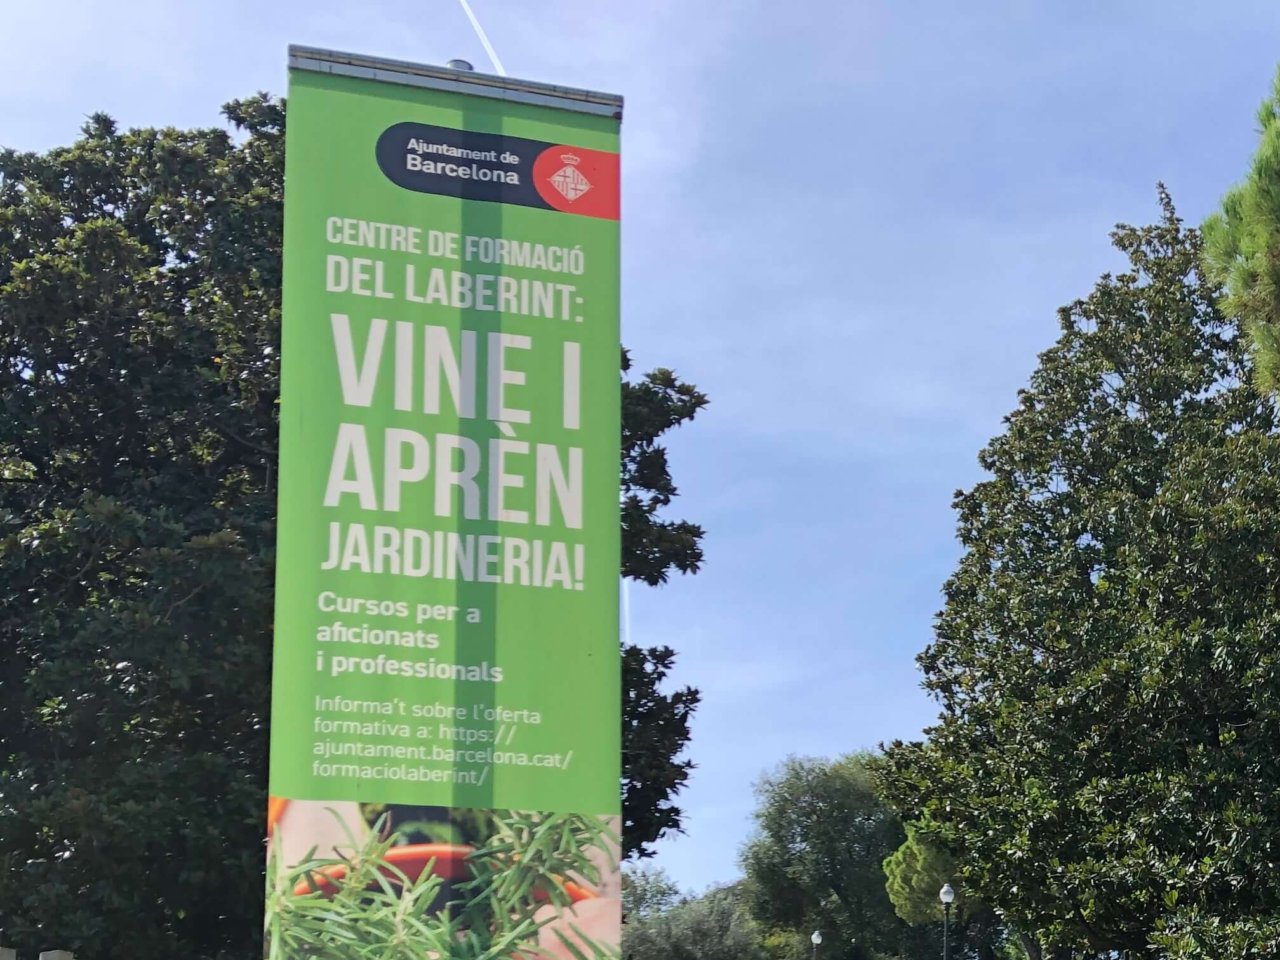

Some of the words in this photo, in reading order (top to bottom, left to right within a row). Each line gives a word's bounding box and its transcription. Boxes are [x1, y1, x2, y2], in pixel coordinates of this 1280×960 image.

[407, 138, 497, 162] Ajuntament
[500, 151, 519, 164] de
[406, 153, 520, 185] Barcelona
[326, 216, 422, 254] CENTRE
[428, 229, 459, 259] DE
[465, 235, 584, 275] FORMACIÓ
[326, 254, 394, 299] DEL
[406, 263, 584, 322] LABERINT:
[330, 313, 532, 424] VINE
[563, 341, 581, 430] I
[323, 422, 584, 529] APRÈN
[321, 521, 585, 591] JARDINERIA!
[318, 591, 409, 617] Cursos
[416, 603, 459, 624] per
[466, 607, 481, 623] a
[316, 621, 440, 649] aficionats
[316, 650, 324, 671] i
[331, 654, 504, 683] professionals
[315, 695, 406, 715] Informa't
[412, 702, 467, 720] sobre
[473, 704, 541, 725] l'oferta
[314, 717, 411, 738] formativa
[416, 726, 433, 739] a:
[438, 723, 518, 745] https://
[312, 740, 574, 770] ajuntament.barcelona.cat/
[312, 760, 489, 787] formaciolaberint/
